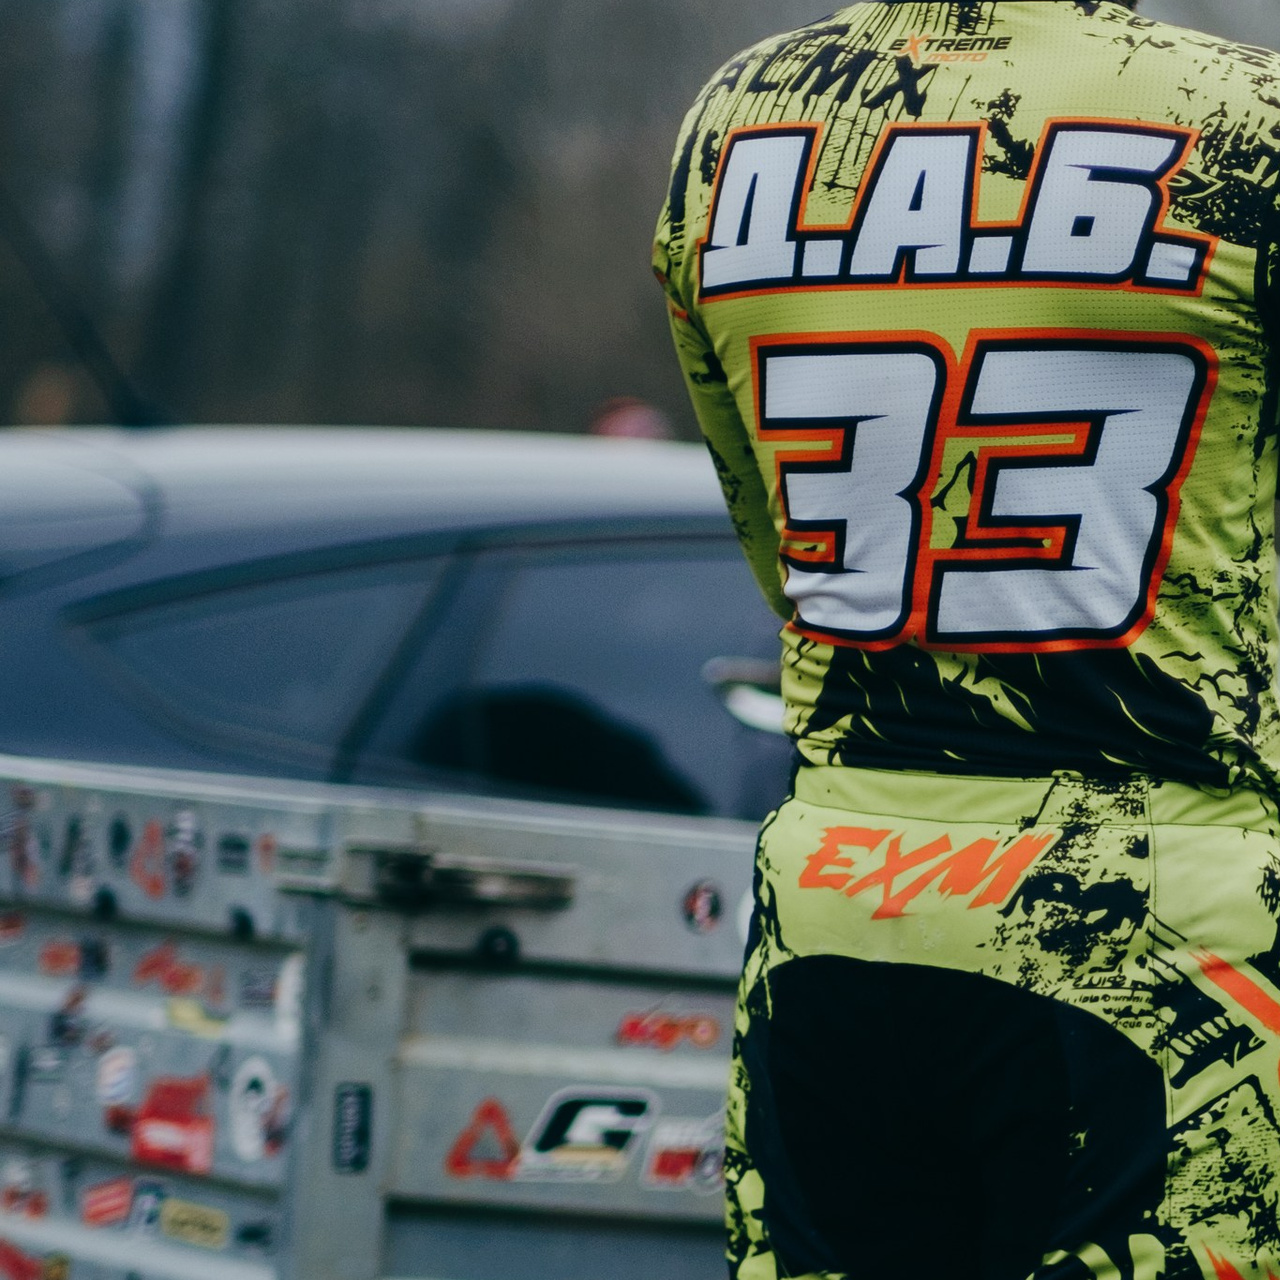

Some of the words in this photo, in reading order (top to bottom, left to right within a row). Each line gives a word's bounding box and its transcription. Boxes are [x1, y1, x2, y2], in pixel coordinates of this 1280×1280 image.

[888, 31, 1012, 62] EXTREME
[925, 52, 988, 63] MOTO
[700, 122, 1208, 294] Д.А.Б.
[757, 337, 1210, 645] 33
[799, 825, 1056, 920] EXM
